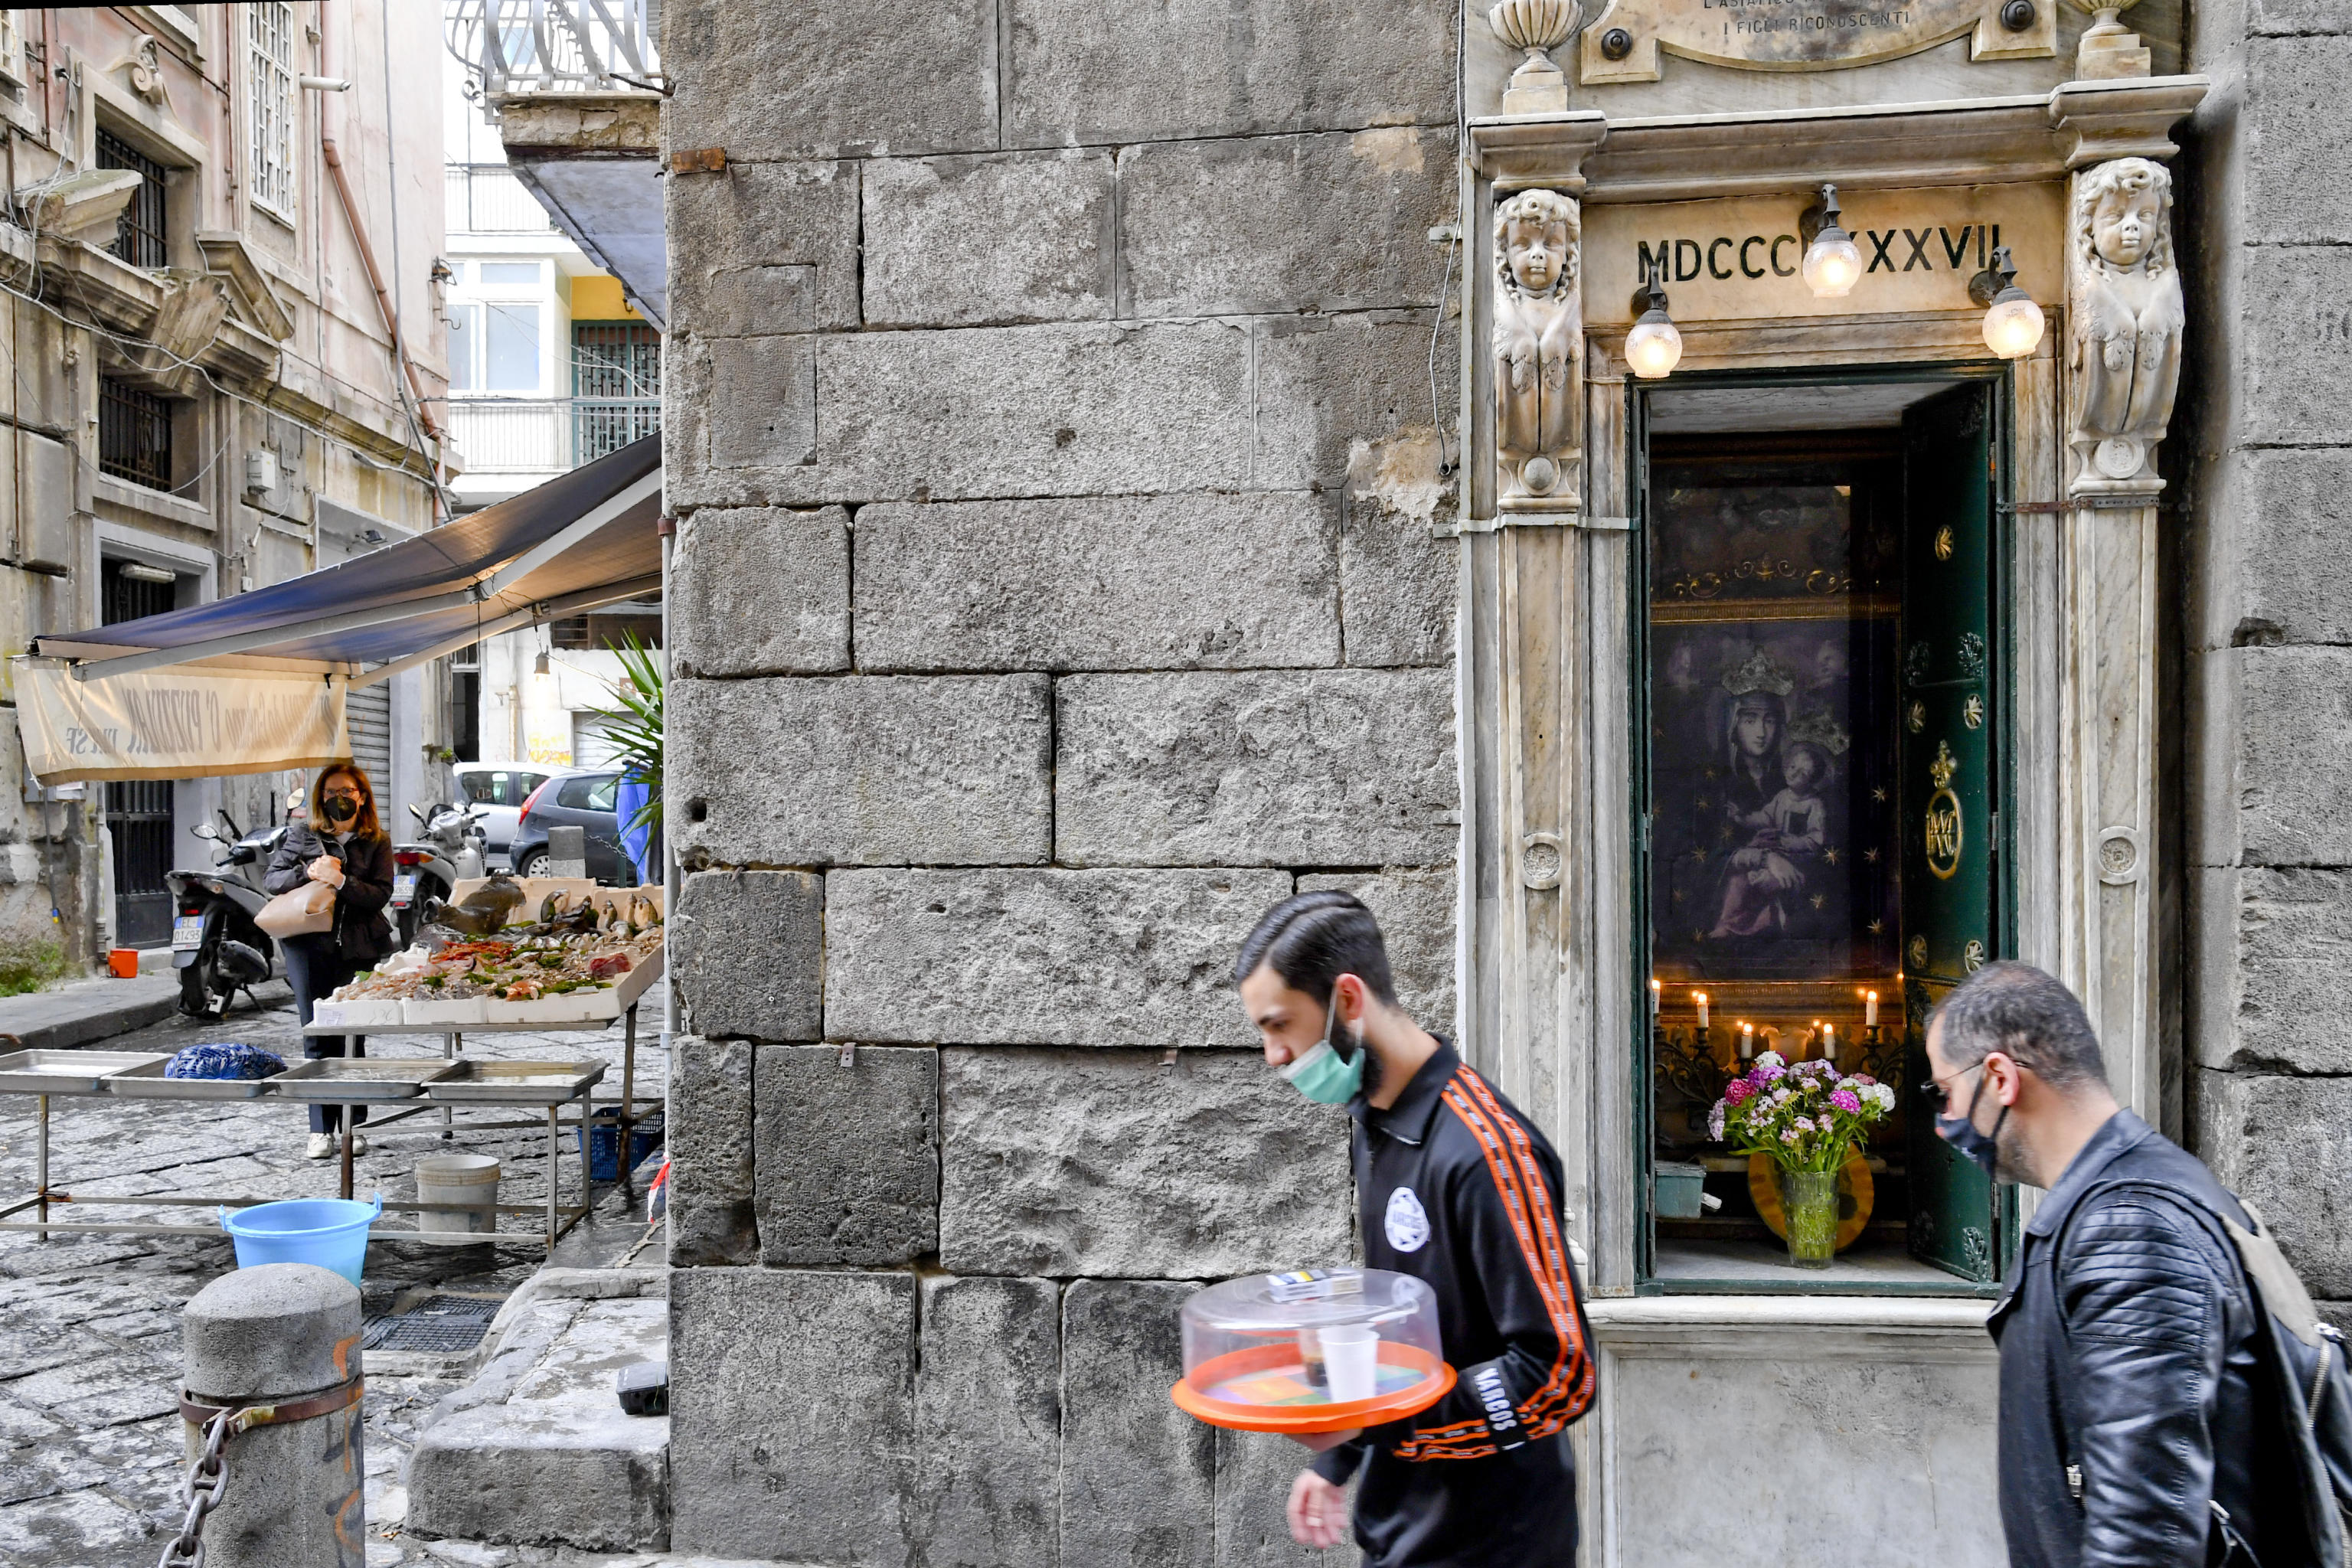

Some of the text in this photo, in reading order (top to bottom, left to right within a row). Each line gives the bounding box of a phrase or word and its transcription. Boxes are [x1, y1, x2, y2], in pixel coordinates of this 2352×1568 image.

[1724, 11, 1909, 34] I FIGLI RICONOSCENTI
[1638, 224, 2001, 283] MDCCCXXVII
